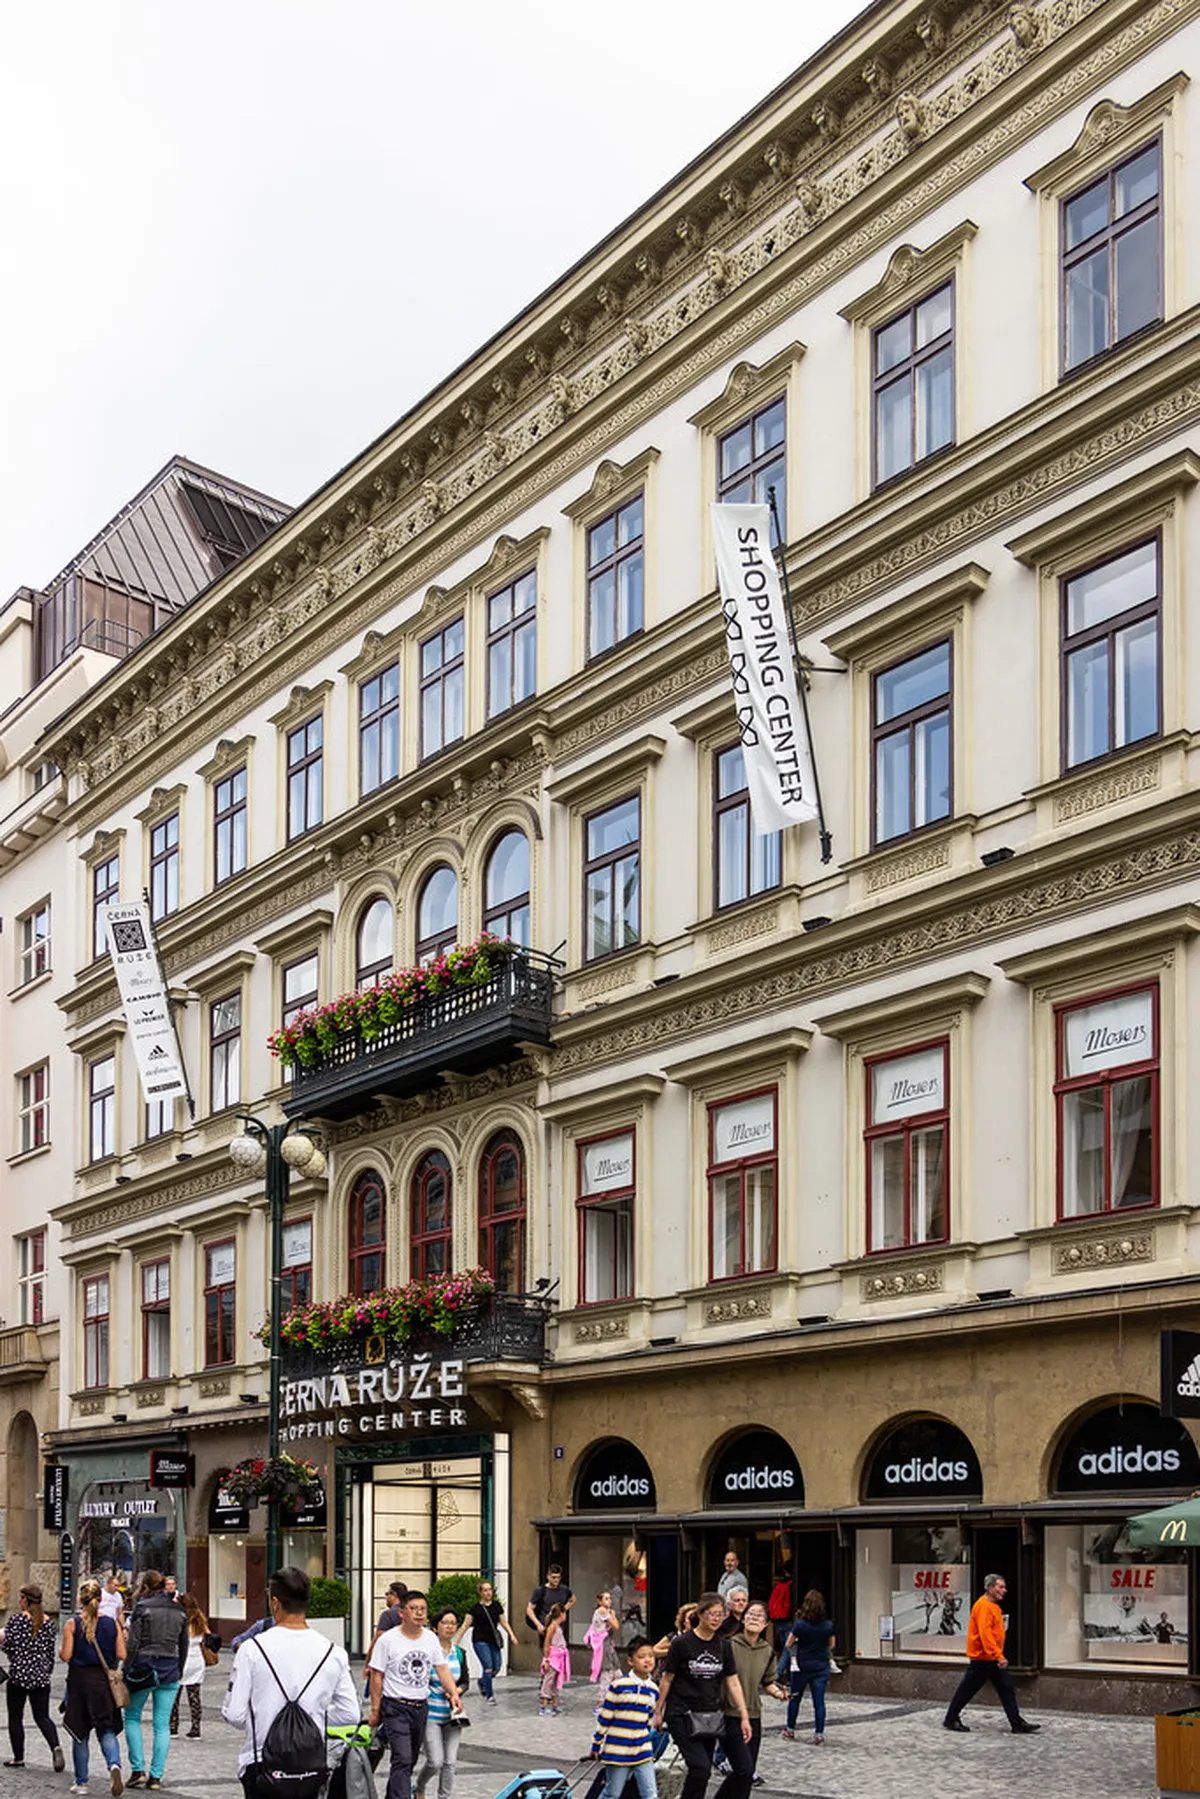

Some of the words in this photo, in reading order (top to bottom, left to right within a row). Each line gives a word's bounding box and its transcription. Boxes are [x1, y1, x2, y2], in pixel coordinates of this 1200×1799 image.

[737, 526, 784, 688] SHOPPING
[765, 694, 802, 806] CENTER
[1082, 1024, 1147, 1058] Moser
[888, 1077, 939, 1107] Moser
[727, 1121, 771, 1148] Moser
[594, 1158, 631, 1182] Moser
[358, 1352, 466, 1405] RŮŽE
[359, 1408, 466, 1432] CENTER
[884, 1456, 968, 1484] adidas
[1078, 1444, 1181, 1475] adidas
[590, 1474, 650, 1497] adidas
[724, 1466, 795, 1490] adidas
[84, 1501, 117, 1517] LUXURY
[124, 1500, 156, 1515] OUTLET
[914, 1571, 951, 1589] SALE
[1110, 1568, 1156, 1588] SALE
